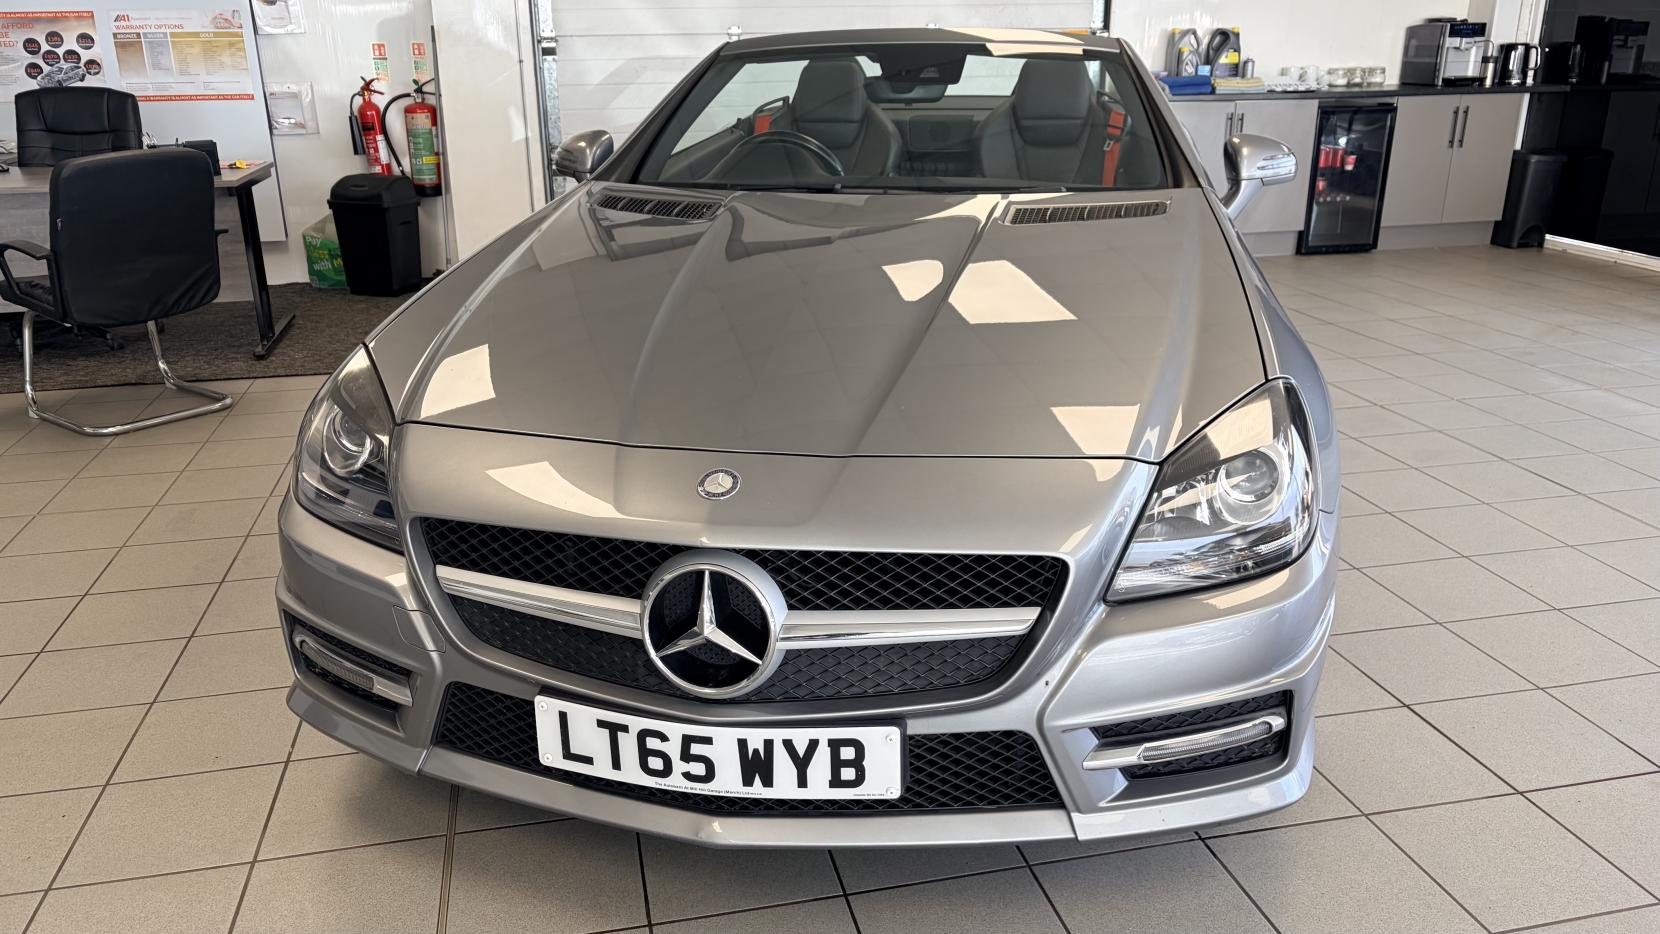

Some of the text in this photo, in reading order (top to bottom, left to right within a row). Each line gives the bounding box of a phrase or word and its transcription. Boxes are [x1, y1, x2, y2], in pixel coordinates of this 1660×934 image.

[305, 236, 321, 248] Pay
[312, 259, 332, 271] with
[558, 710, 866, 789] LT65 WYB
